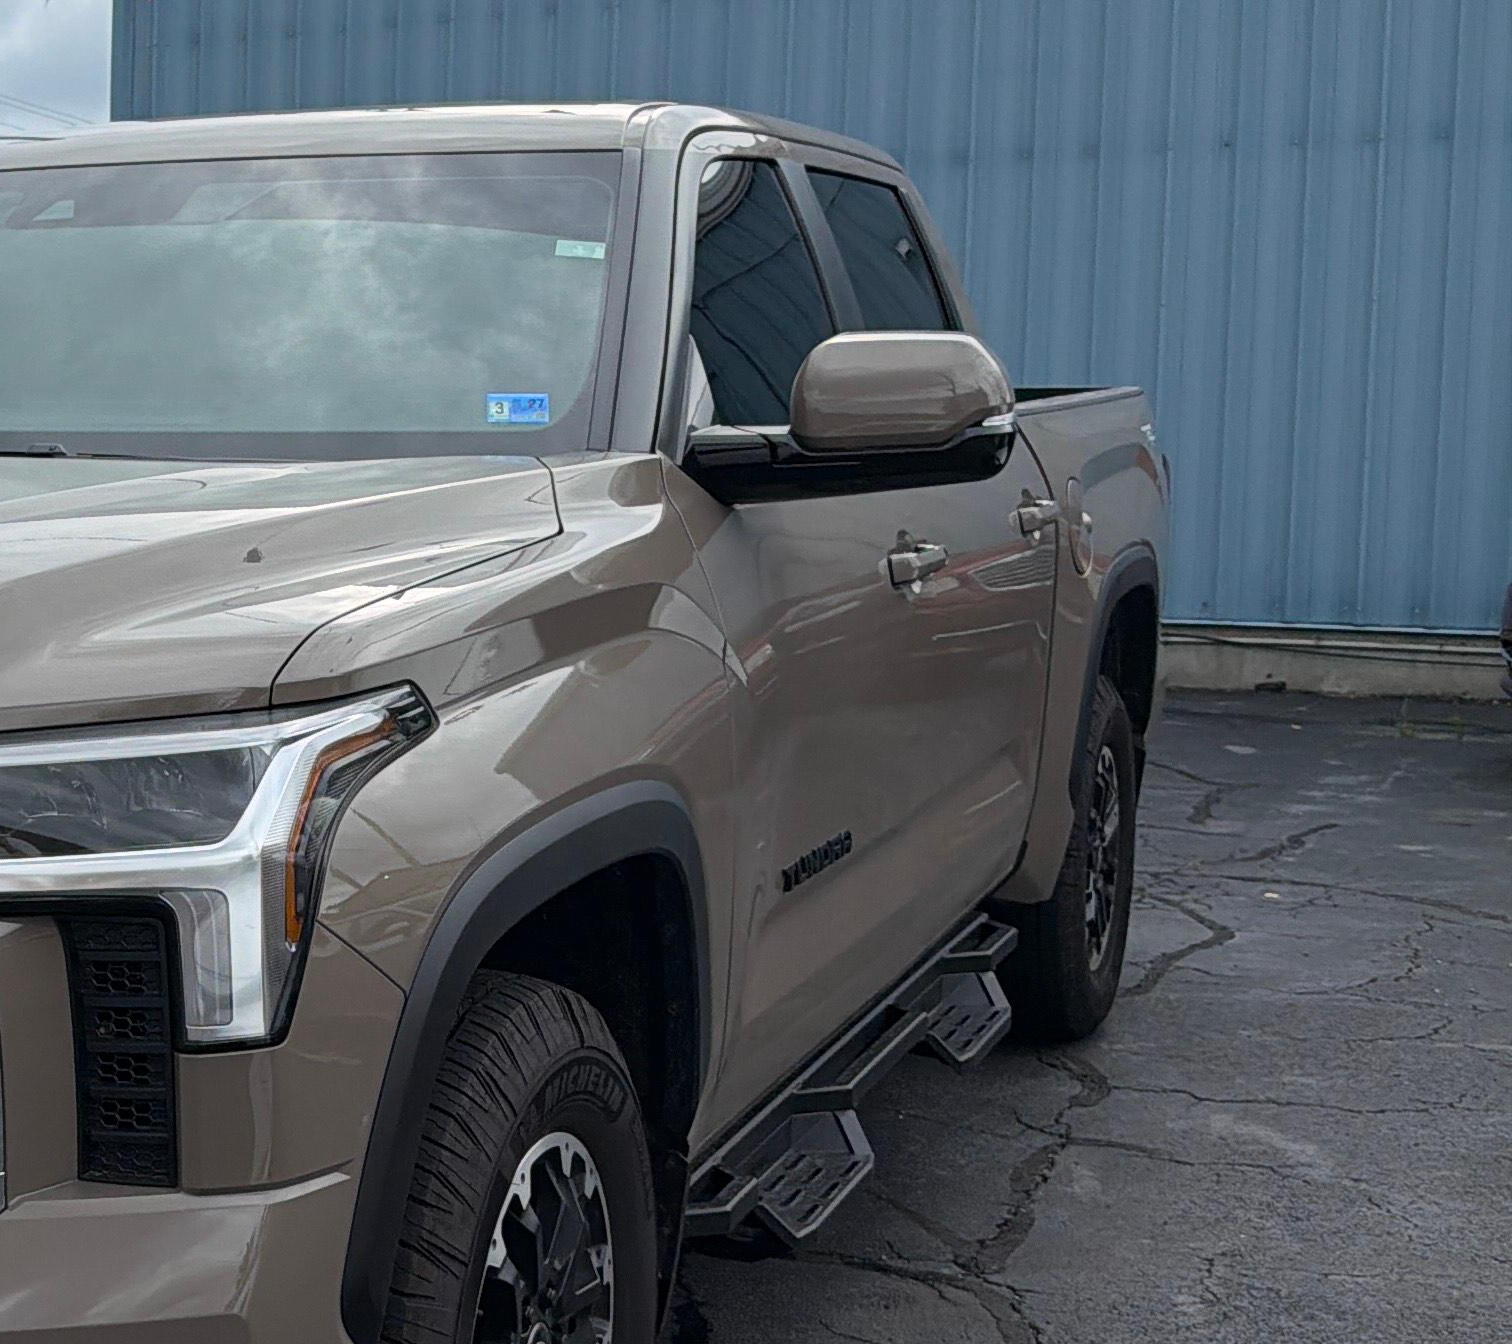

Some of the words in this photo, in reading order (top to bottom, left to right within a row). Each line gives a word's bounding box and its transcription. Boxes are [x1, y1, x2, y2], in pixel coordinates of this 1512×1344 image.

[495, 401, 505, 414] 3
[528, 398, 545, 409] 27
[781, 830, 853, 893] TUNDRA
